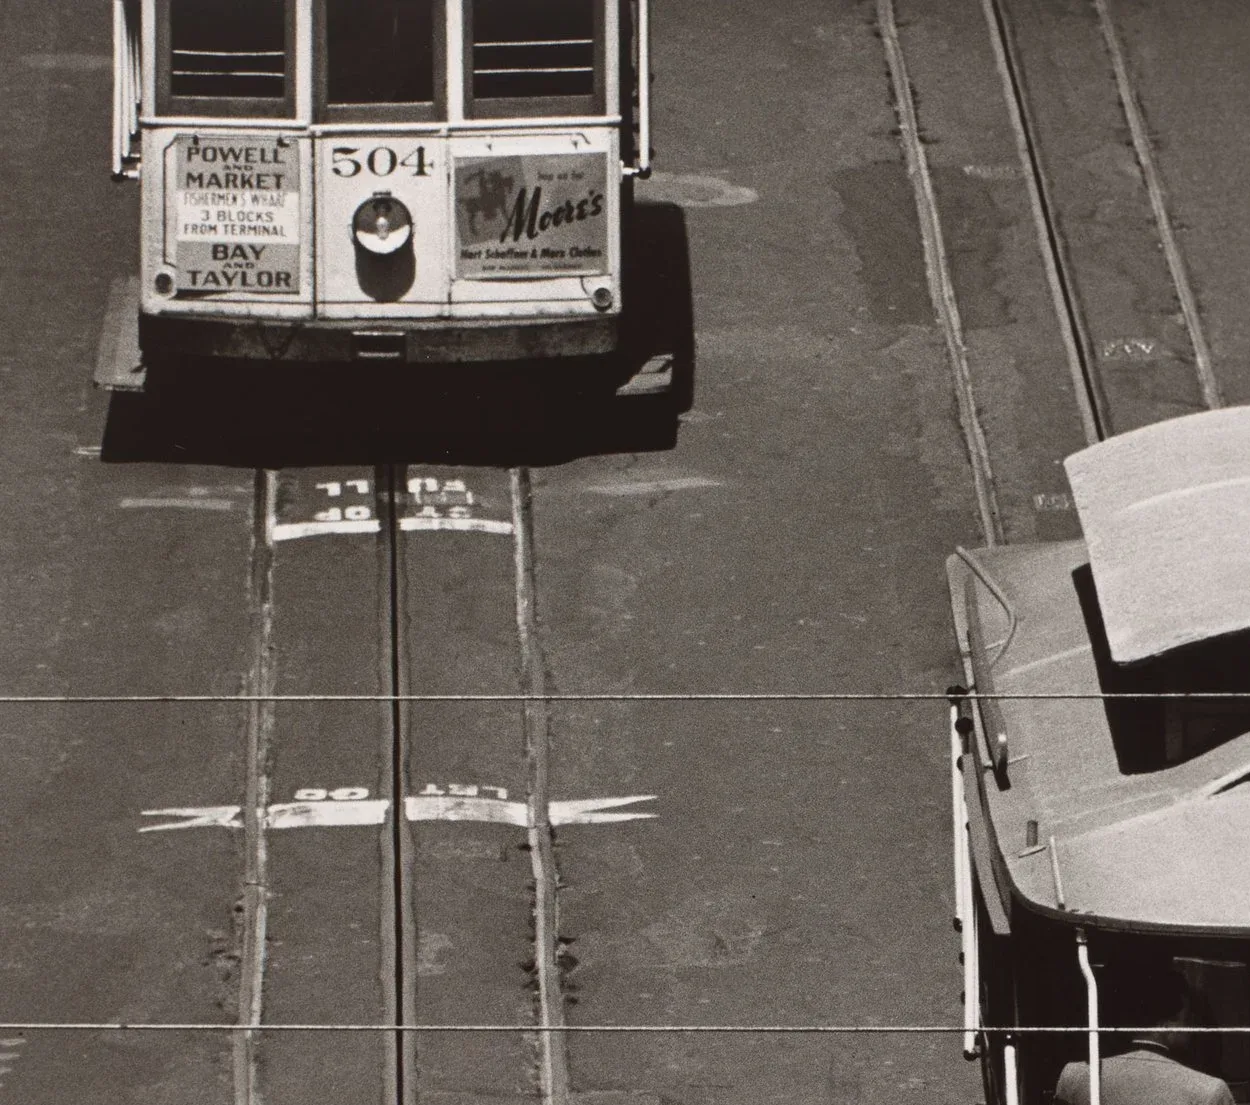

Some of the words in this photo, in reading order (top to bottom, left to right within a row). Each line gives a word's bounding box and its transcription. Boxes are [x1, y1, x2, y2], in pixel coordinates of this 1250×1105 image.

[187, 146, 286, 164] POWELL
[331, 146, 433, 178] 504
[186, 172, 284, 190] MARKET
[200, 210, 210, 222] 3
[217, 210, 275, 223] BLOCKS
[501, 186, 604, 243] Moore's
[184, 224, 217, 236] FROM
[224, 224, 287, 238] TERMINAL
[212, 244, 266, 261] BAY
[187, 270, 292, 288] TAYLOR
